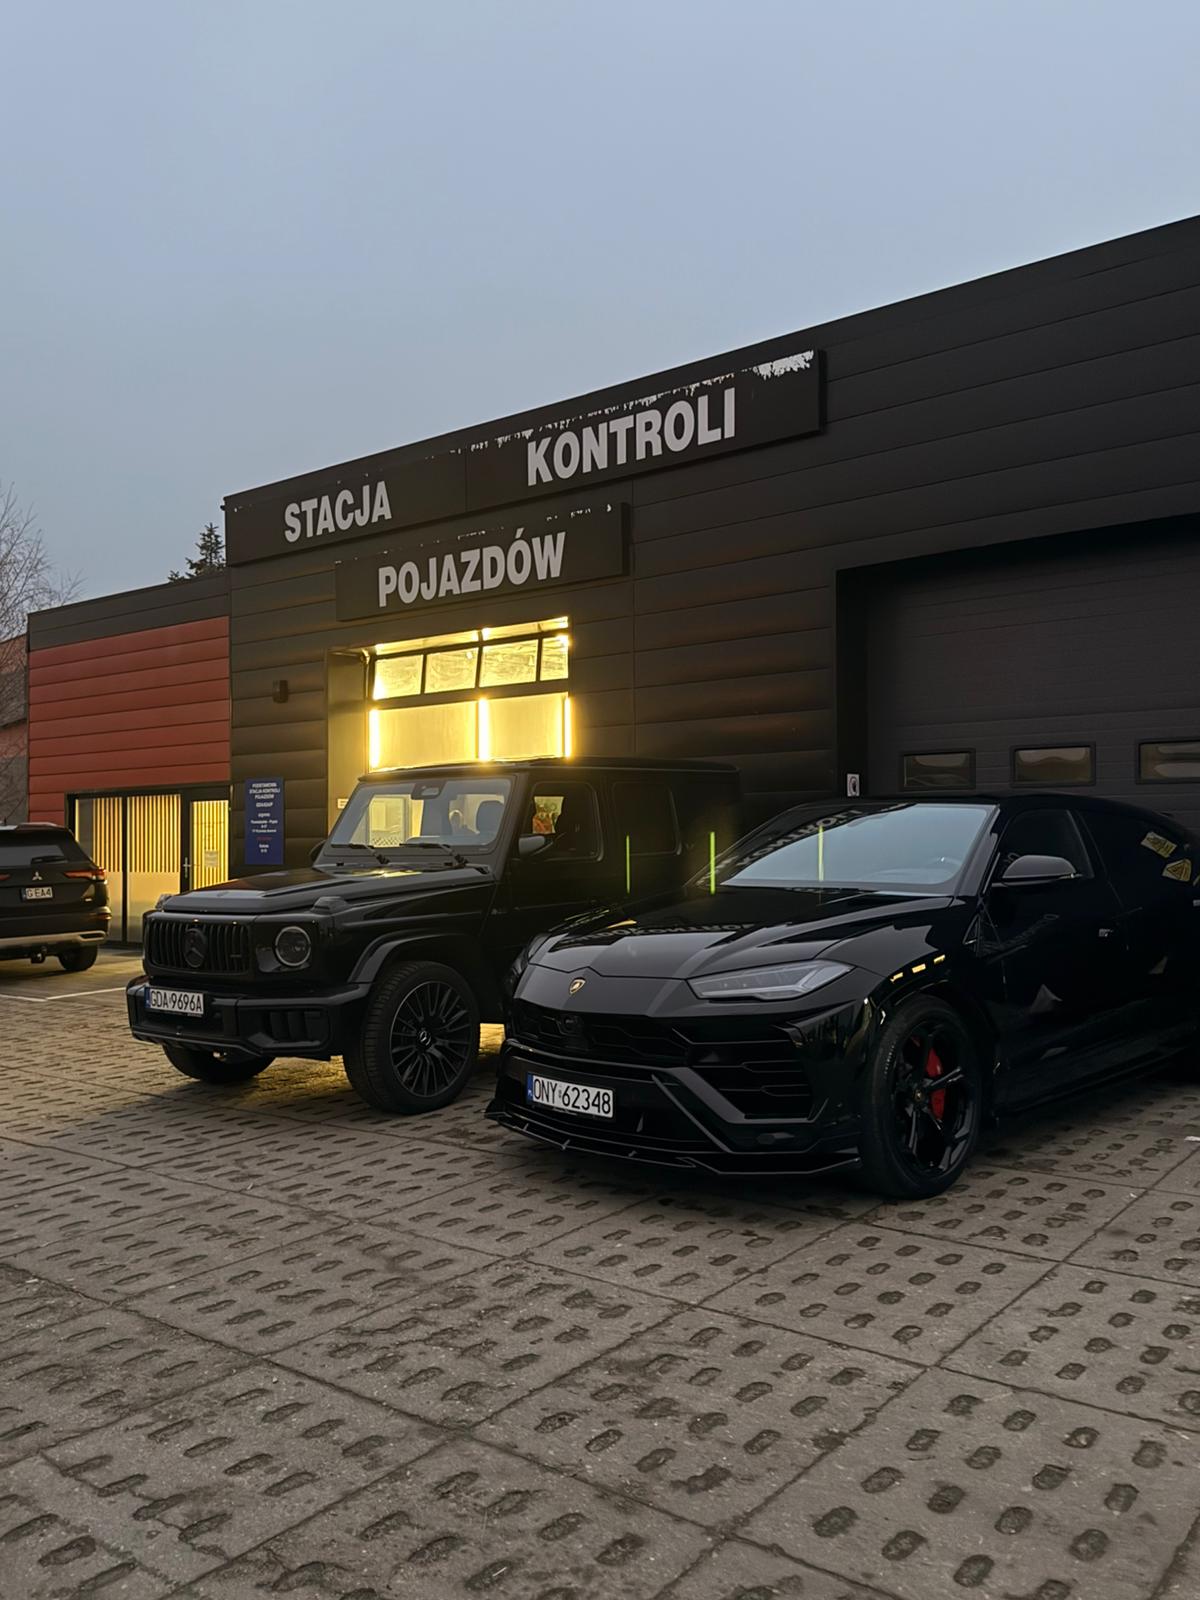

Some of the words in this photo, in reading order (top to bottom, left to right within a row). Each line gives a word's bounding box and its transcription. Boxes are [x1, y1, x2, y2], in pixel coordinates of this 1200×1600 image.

[284, 480, 392, 543] STACJA
[527, 387, 736, 487] KONTROLI
[378, 527, 566, 608] POJAZDÓW
[151, 990, 169, 1008] GDA
[171, 992, 202, 1012] 9696A
[533, 1078, 558, 1104] ONY
[562, 1085, 611, 1114] 62348
